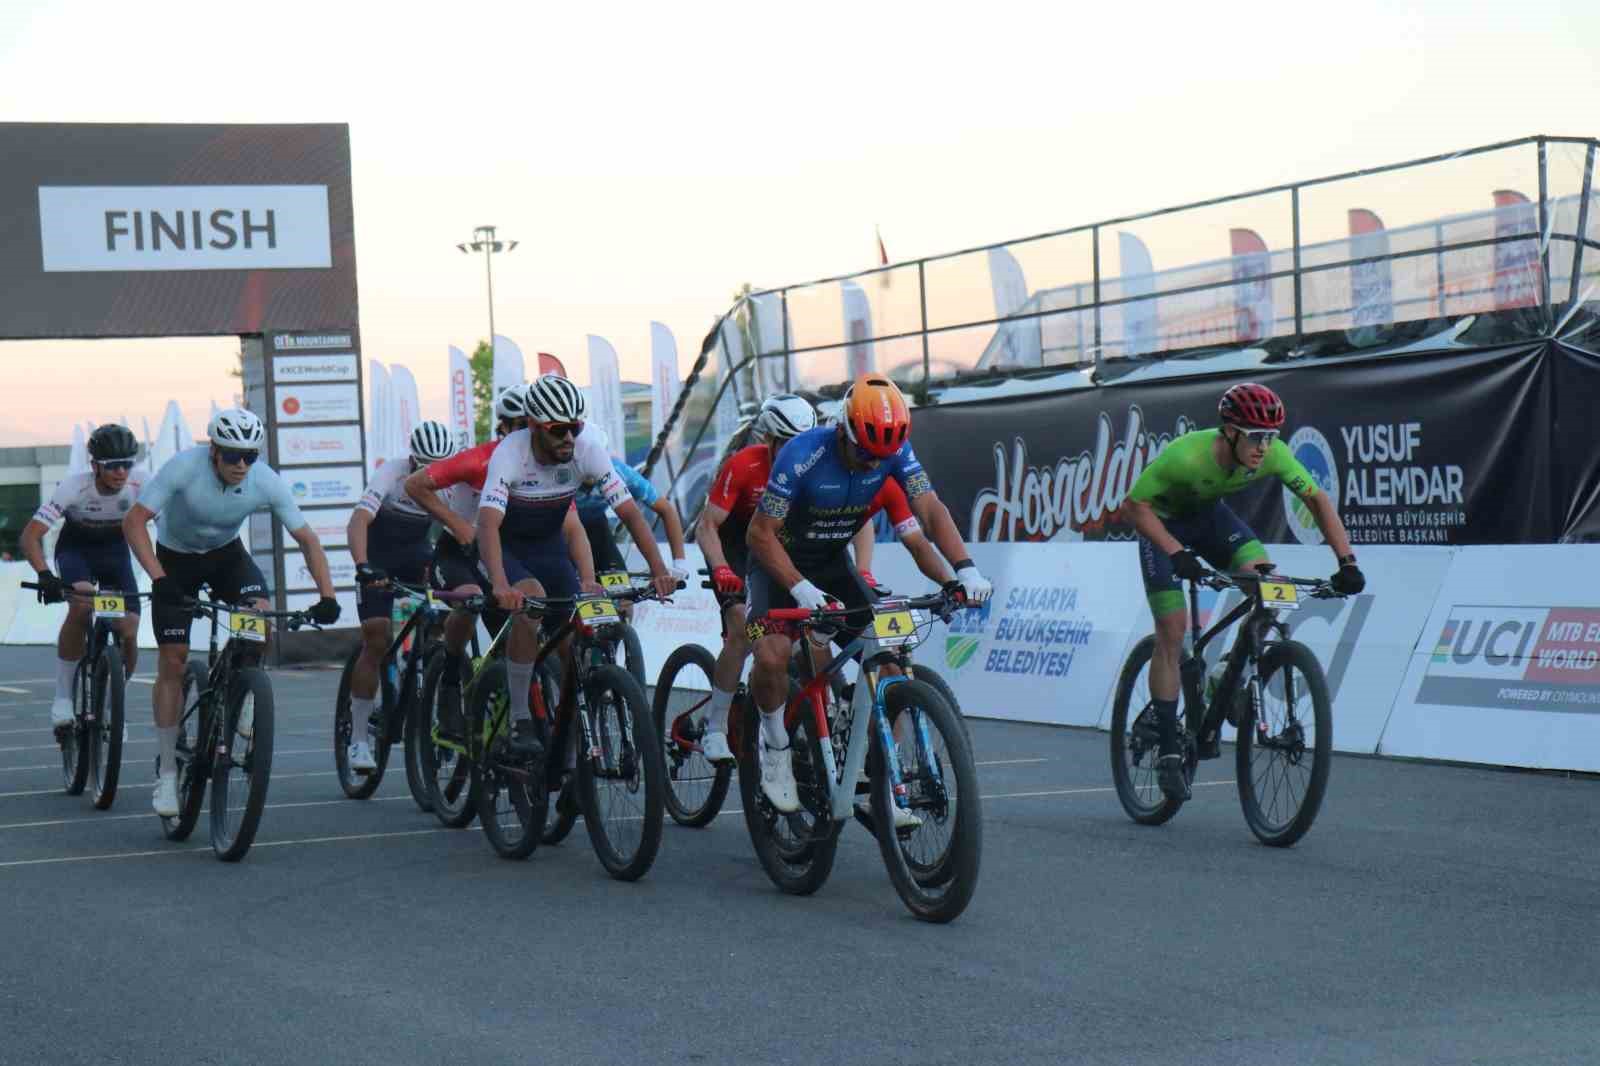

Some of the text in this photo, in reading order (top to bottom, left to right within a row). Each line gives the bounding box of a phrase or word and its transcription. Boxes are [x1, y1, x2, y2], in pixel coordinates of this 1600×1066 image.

[105, 209, 277, 251] FINISH
[1340, 423, 1421, 464] YUSUF
[1344, 465, 1464, 506] ALEMDAR
[1345, 514, 1392, 527] SAKARYA
[608, 576, 624, 586] 21
[1006, 586, 1079, 612] SAKARYA
[1272, 586, 1286, 600] 2
[101, 600, 118, 612] 19
[591, 602, 605, 615] 5
[239, 617, 258, 632] 12
[888, 617, 902, 634] 4
[1546, 621, 1600, 643] MTB E
[1452, 620, 1537, 667] UCI
[984, 646, 1076, 677] BELEDİYESİ
[1536, 649, 1598, 670] WORLD
